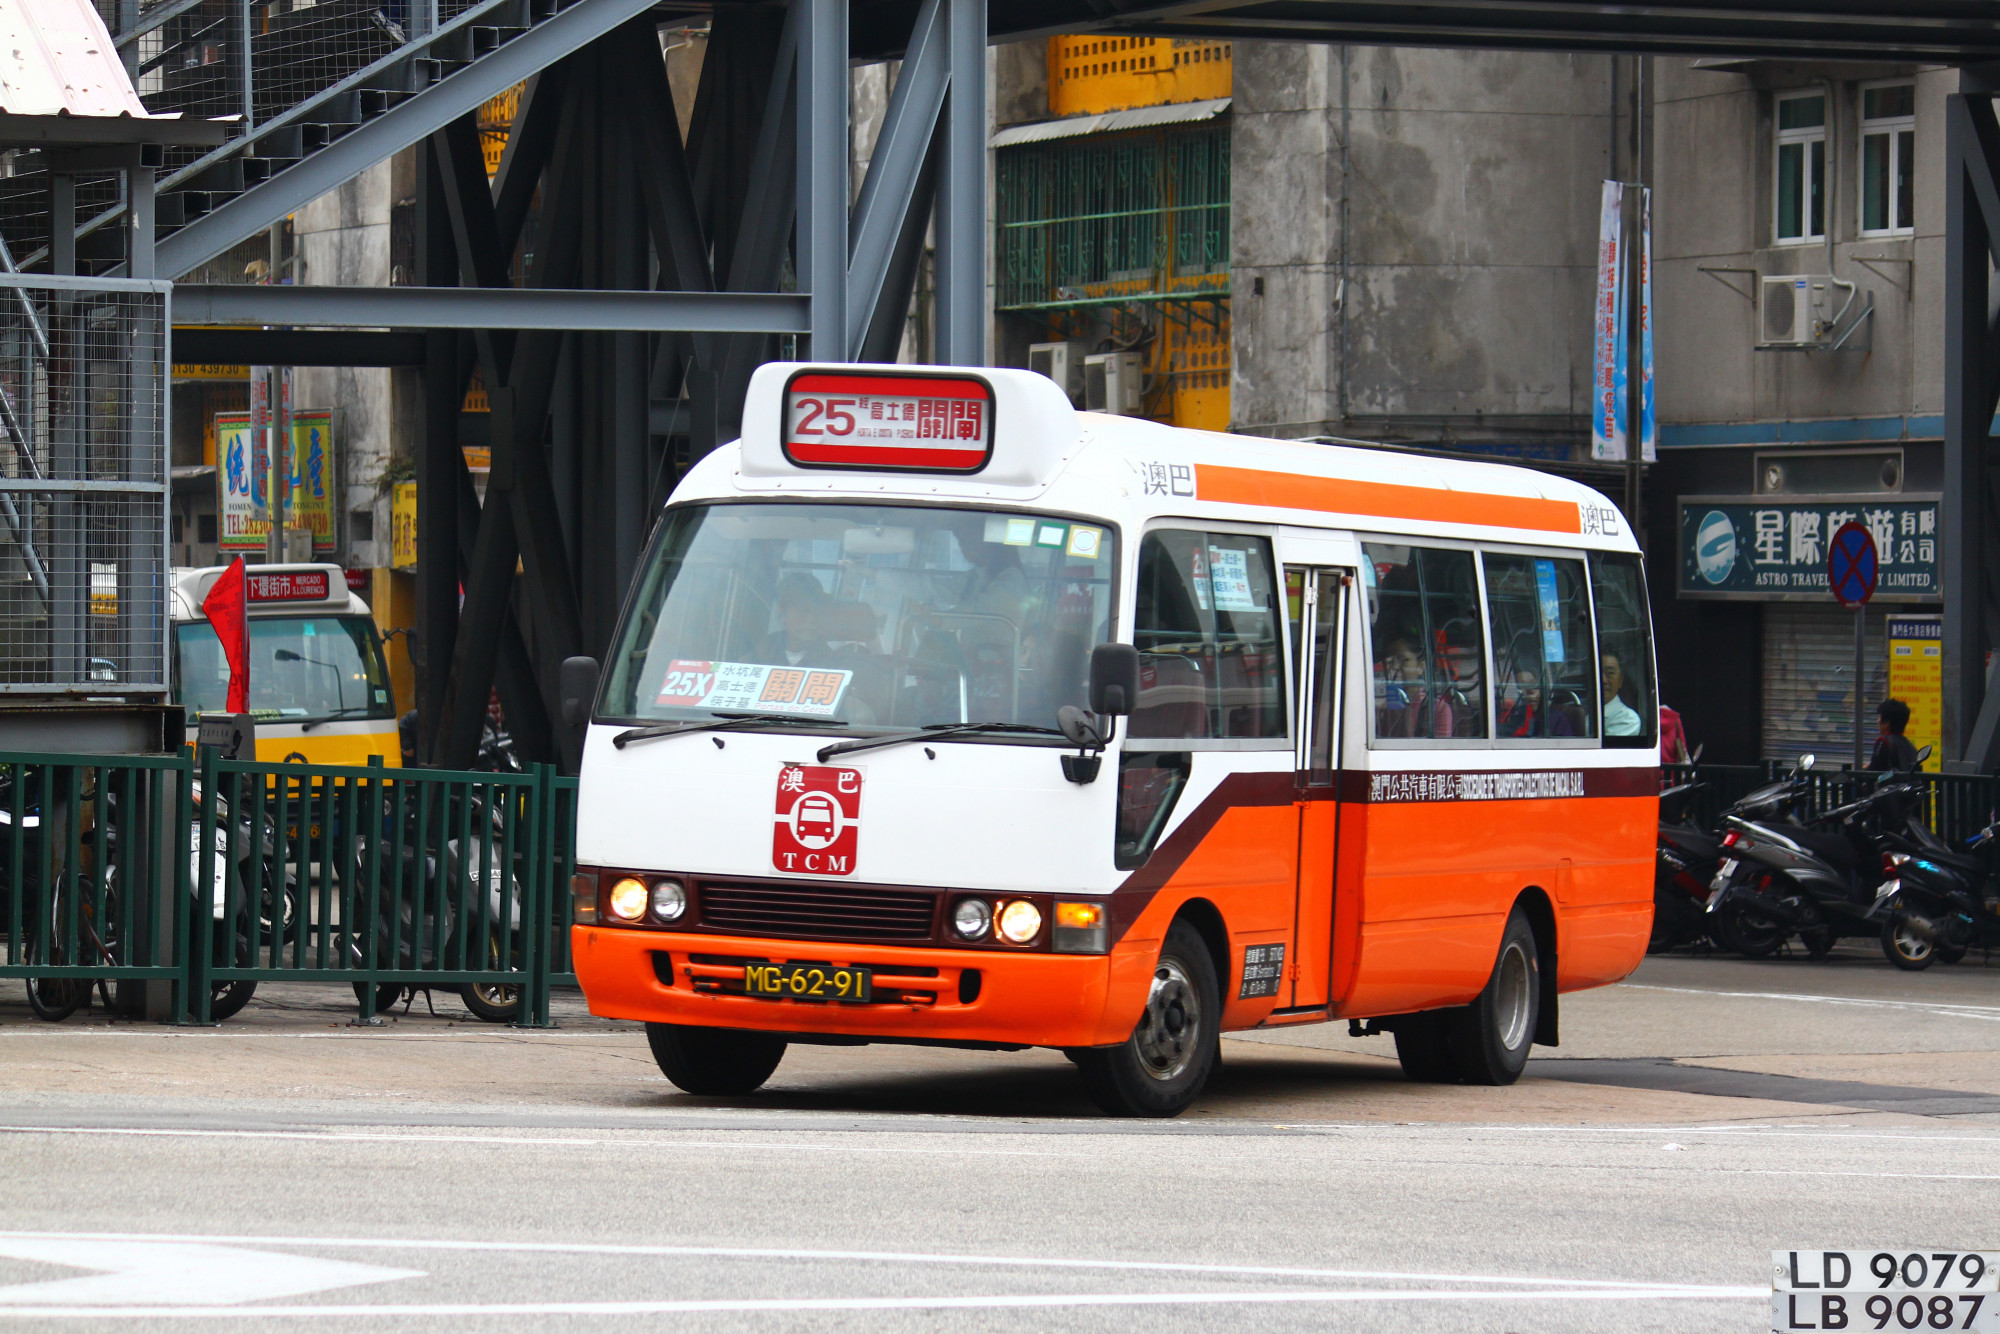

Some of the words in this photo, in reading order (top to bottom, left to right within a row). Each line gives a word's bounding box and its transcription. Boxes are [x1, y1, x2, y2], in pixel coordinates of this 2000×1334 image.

[795, 398, 856, 437] 25
[871, 401, 915, 421] 高士德
[917, 399, 982, 441] 關閘
[1140, 461, 1194, 497] 澳巴
[1581, 504, 1619, 537] 澳巴
[1900, 539, 1935, 564] 公司
[248, 576, 291, 597] 下環街市
[295, 575, 321, 585] MERCADO
[1756, 573, 1788, 586] ASTRO
[1792, 572, 1830, 586] TRAVEL
[1888, 572, 1930, 586] LIMITED
[722, 664, 764, 678] 水坑尾
[660, 671, 713, 697] 25X
[715, 680, 758, 693] 高士德
[758, 668, 846, 706] 關閘
[710, 695, 751, 708] 筷子基
[754, 702, 784, 711] Portas
[802, 705, 831, 714] Cerco
[1371, 774, 1464, 801] 澳門公共汽車有限公司
[746, 965, 863, 998] MG-62-91
